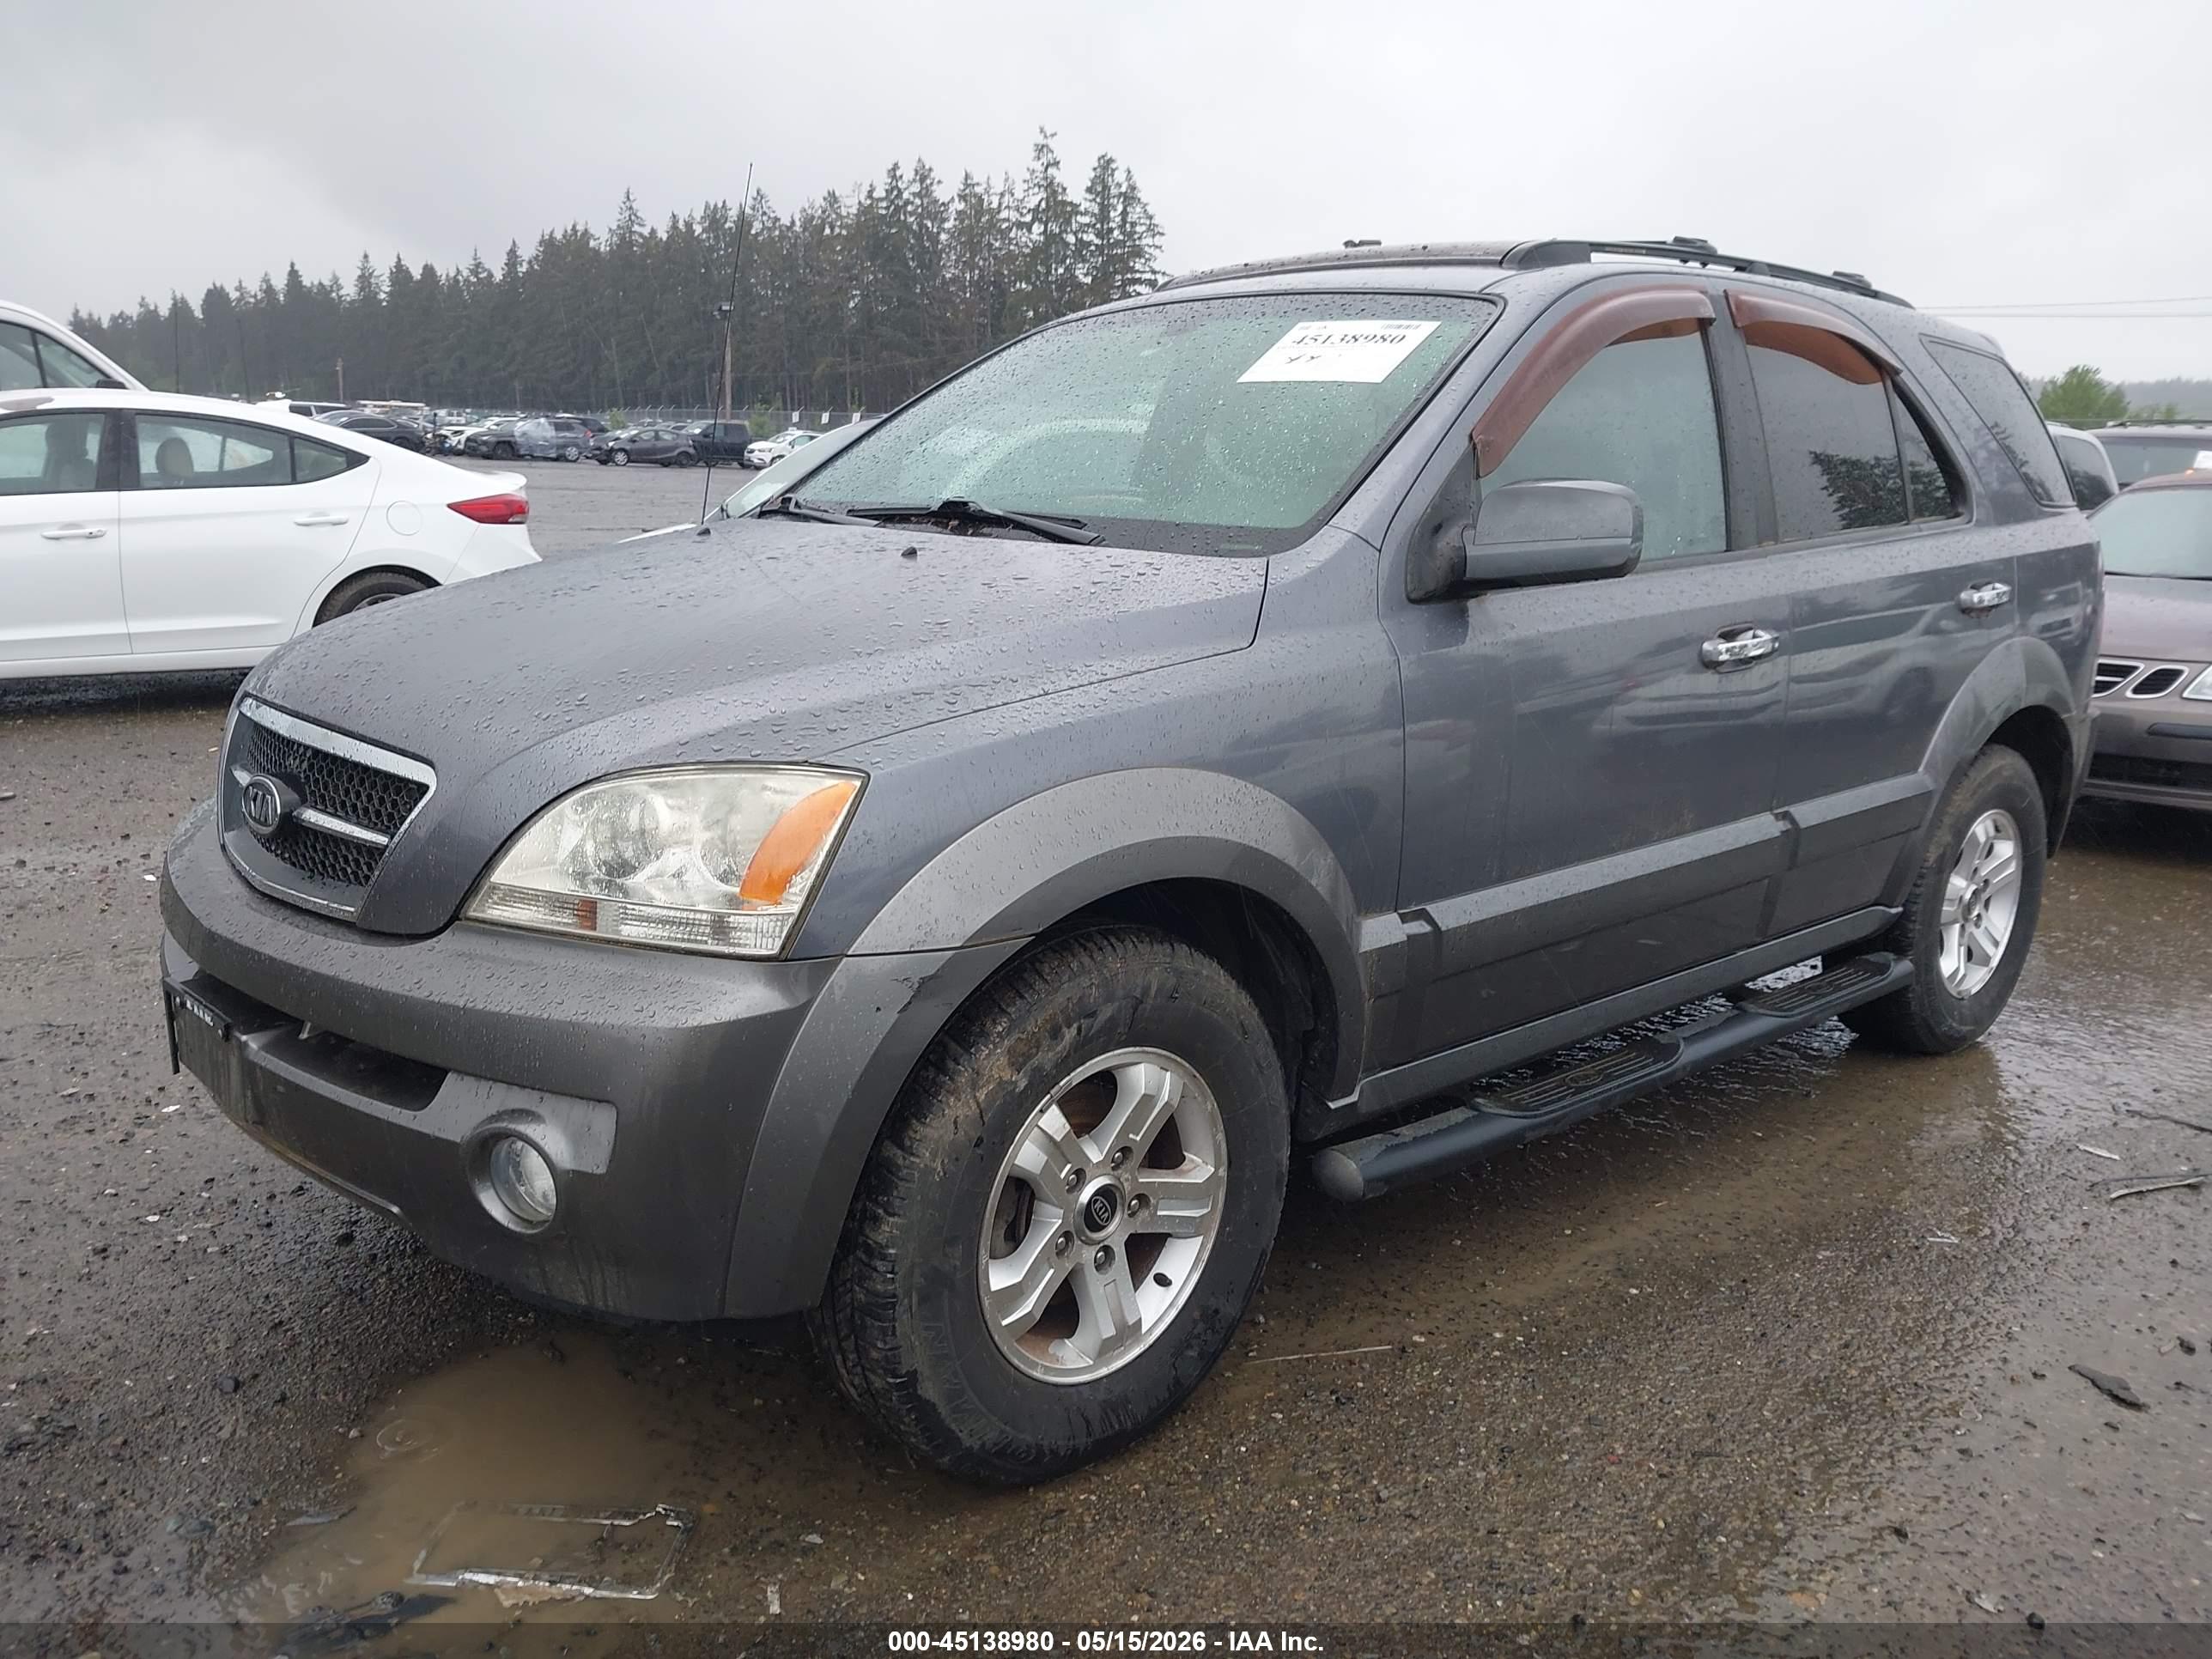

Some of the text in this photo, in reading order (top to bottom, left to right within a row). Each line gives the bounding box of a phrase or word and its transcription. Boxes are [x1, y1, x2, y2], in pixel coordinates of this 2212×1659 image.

[1291, 333, 1407, 345] 45138980
[247, 785, 272, 825] KIA
[1094, 1199, 1109, 1224] KIA
